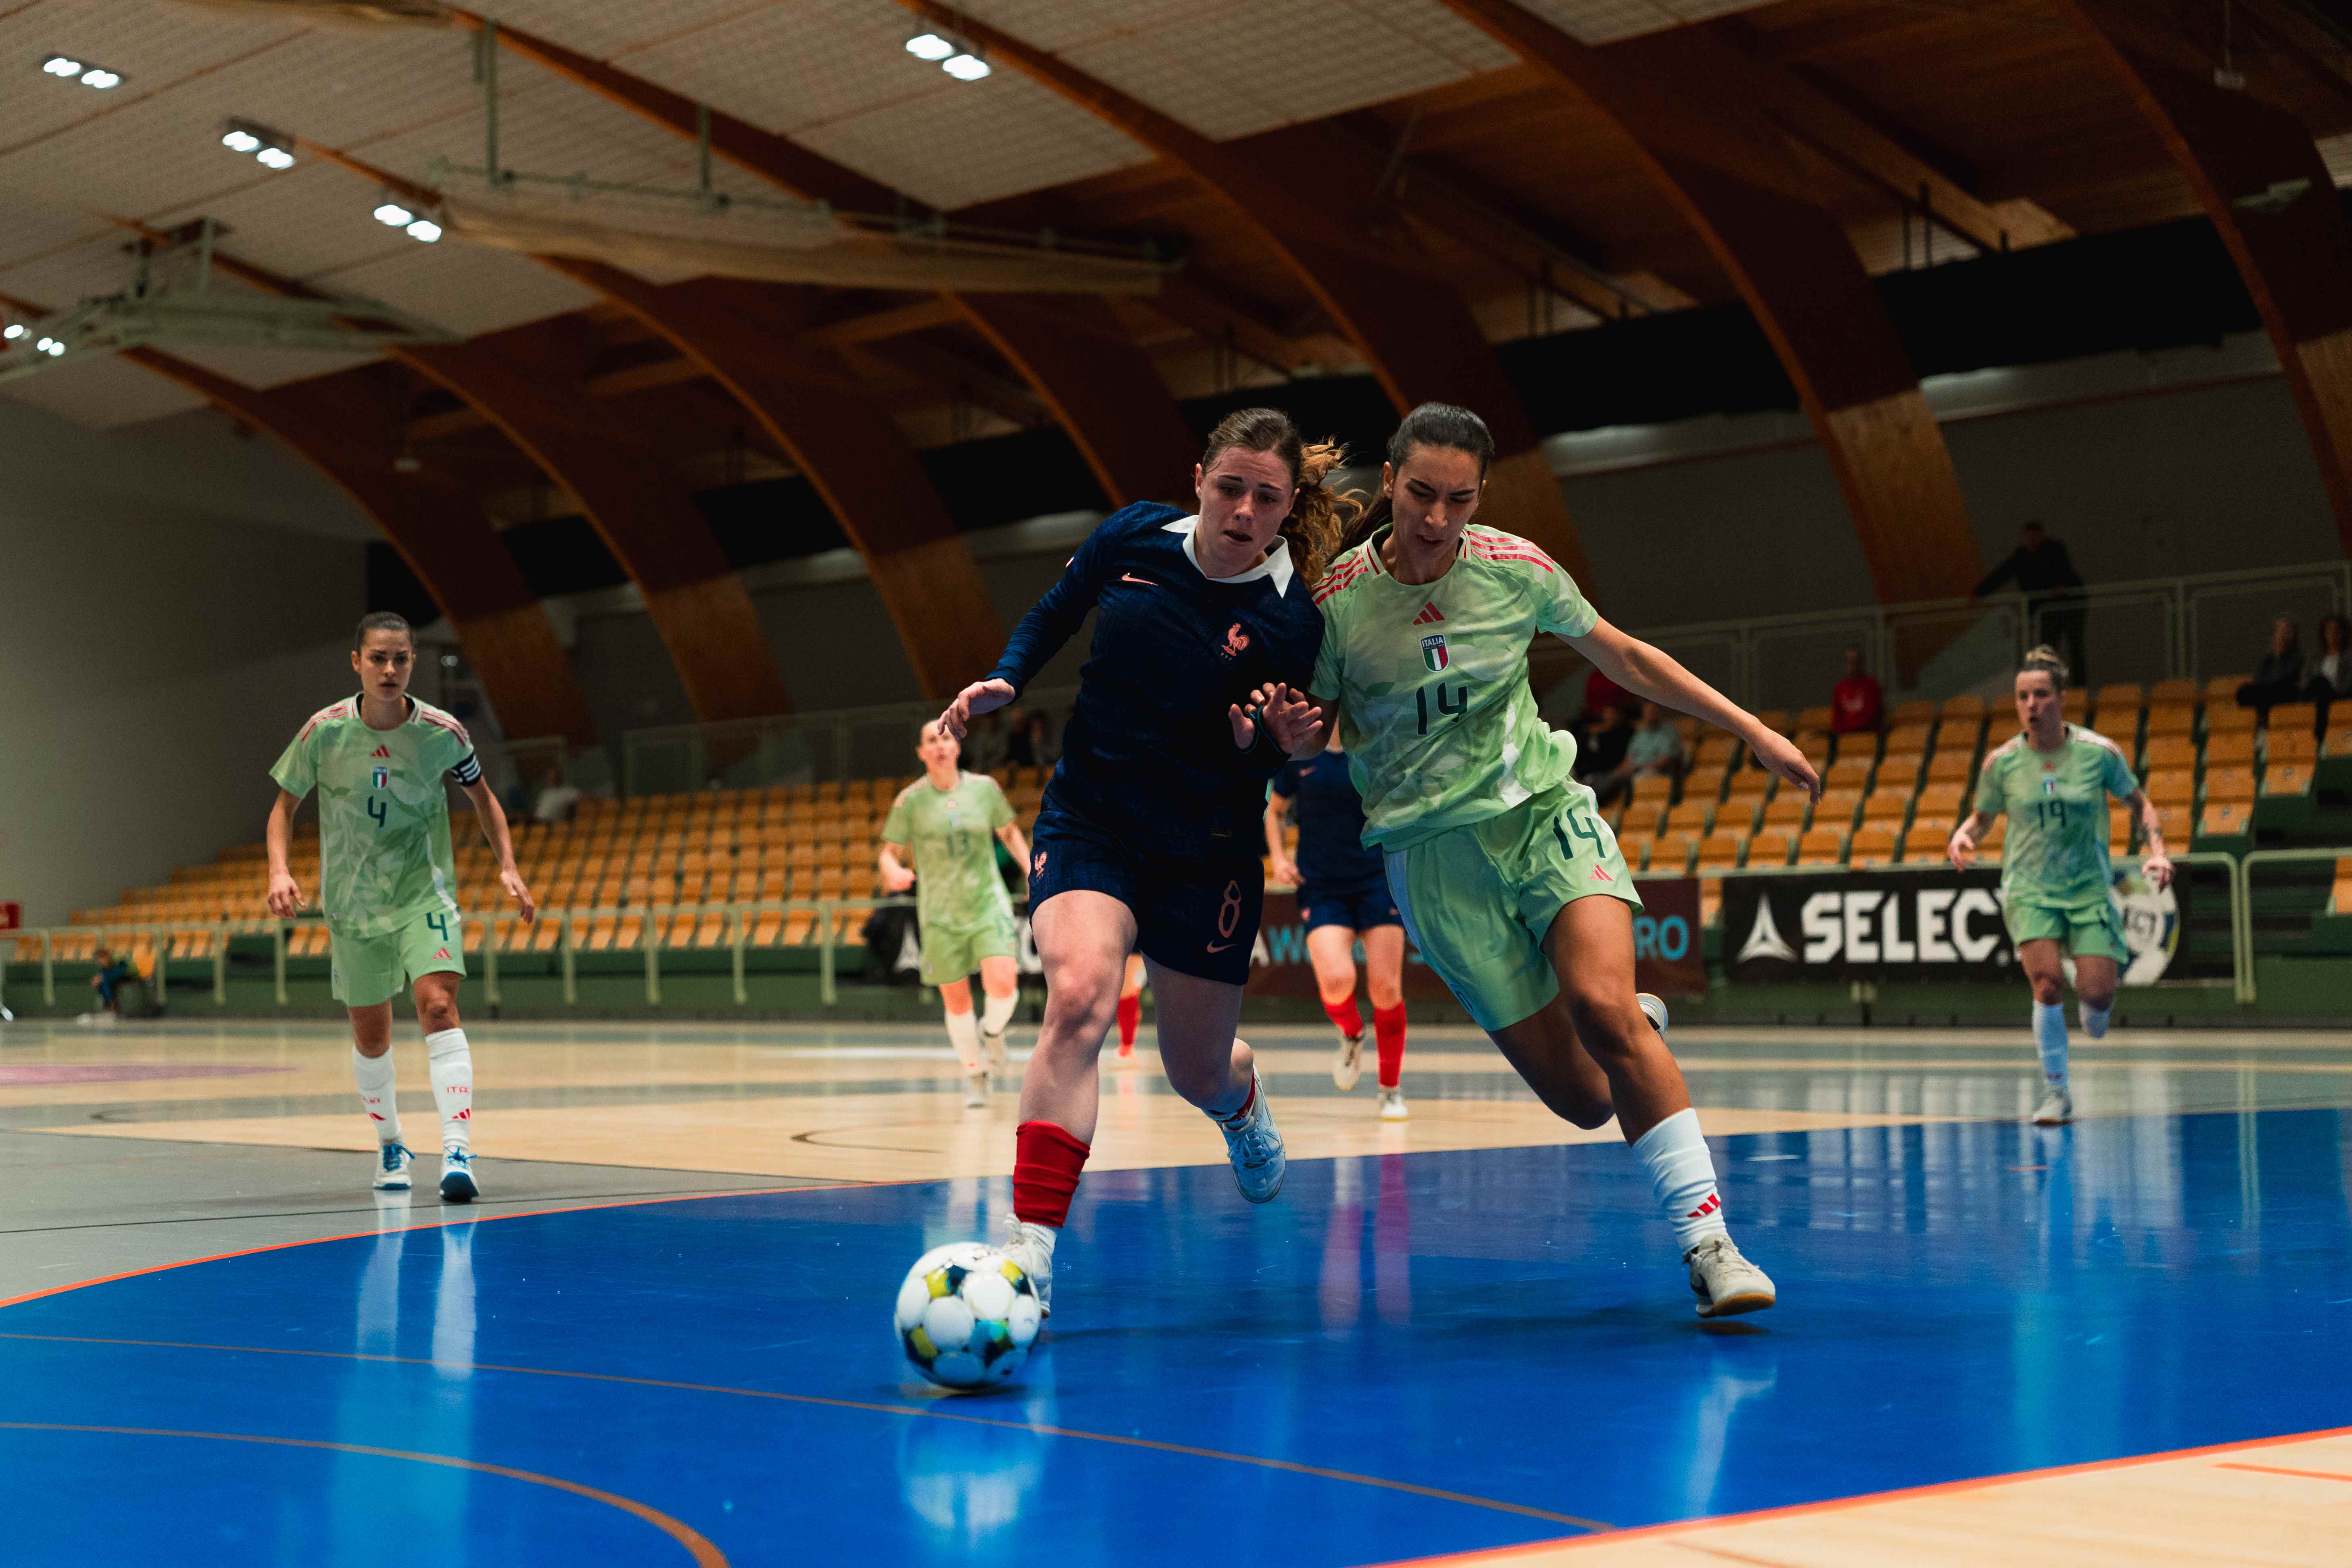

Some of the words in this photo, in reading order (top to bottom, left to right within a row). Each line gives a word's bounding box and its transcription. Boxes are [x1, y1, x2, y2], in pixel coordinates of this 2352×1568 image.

[1421, 637, 1444, 647] ITALIA
[1416, 682, 1468, 735] 14
[367, 795, 386, 828] 4
[2038, 800, 2066, 829] 19
[1552, 808, 1606, 860] 14
[426, 912, 449, 941] 4
[1218, 880, 1242, 938] 8
[1800, 888, 2010, 963] SELEC
